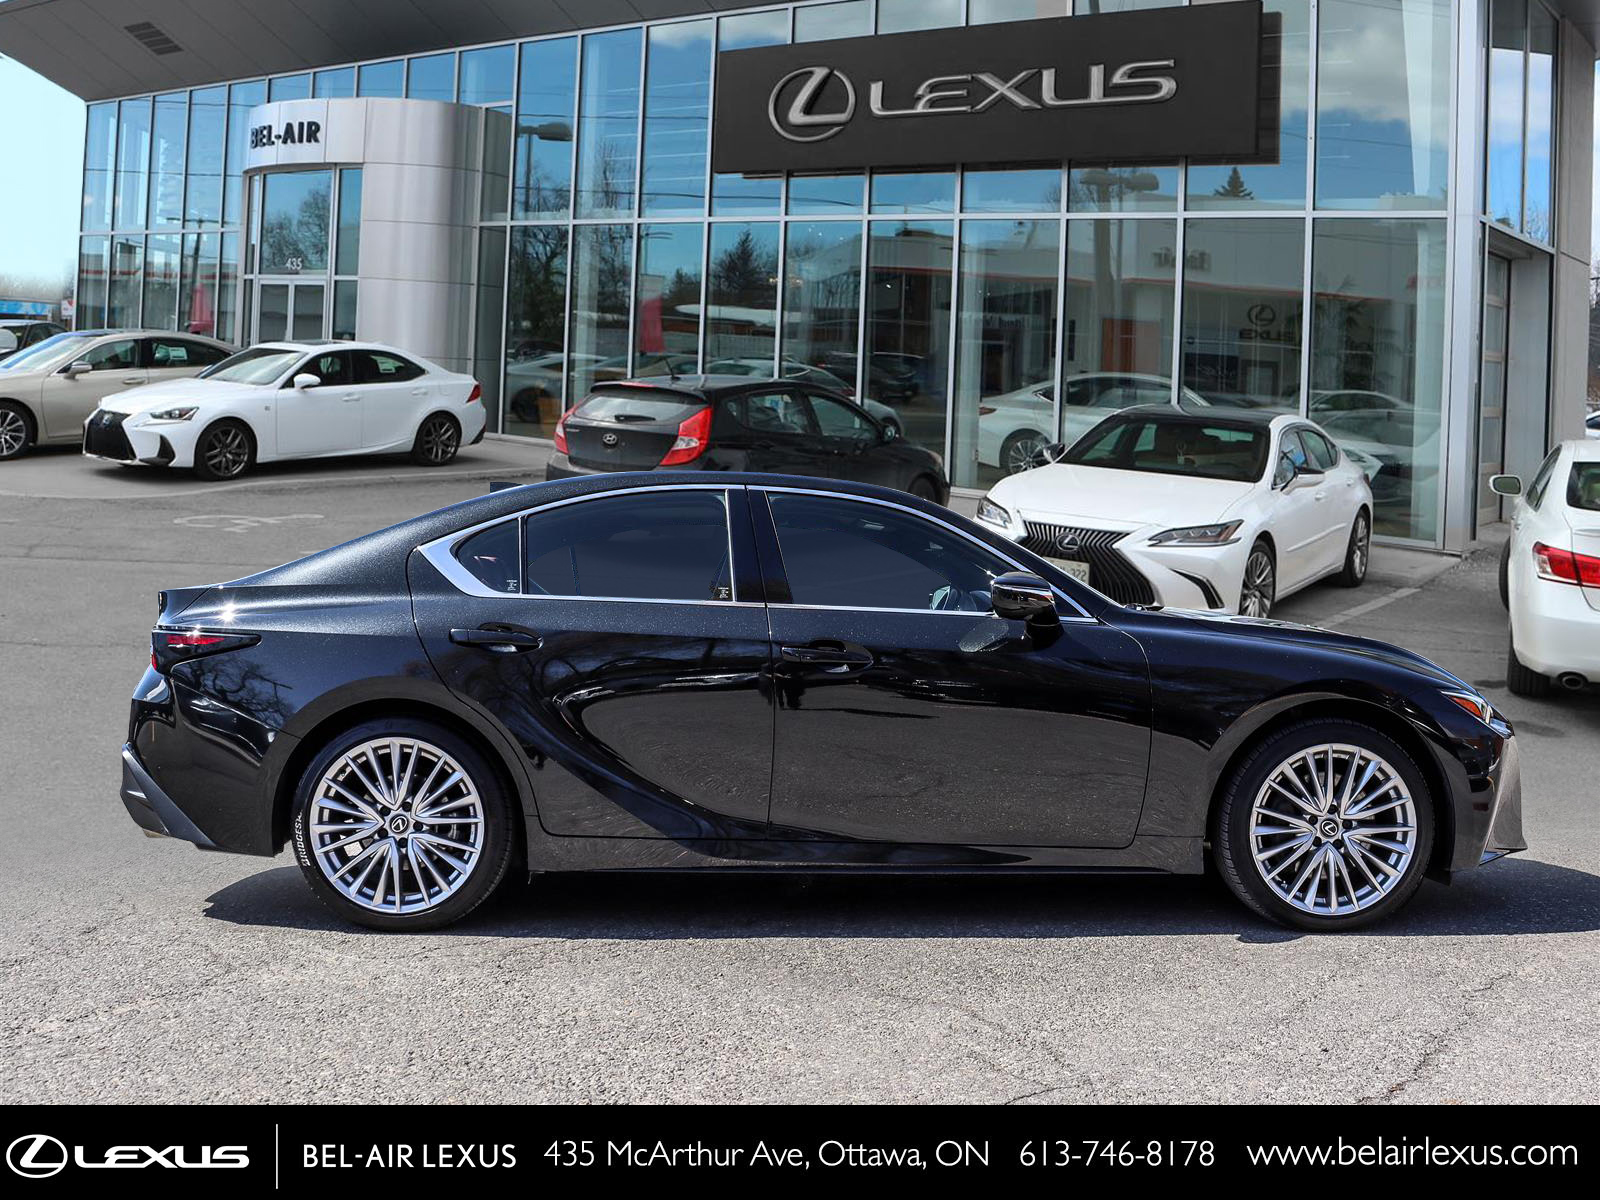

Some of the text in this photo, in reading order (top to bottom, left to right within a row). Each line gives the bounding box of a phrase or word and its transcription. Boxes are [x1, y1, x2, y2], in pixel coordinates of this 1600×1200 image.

[870, 59, 1177, 118] LEXUS
[250, 120, 321, 149] BEL-AIR
[285, 257, 303, 271] 435
